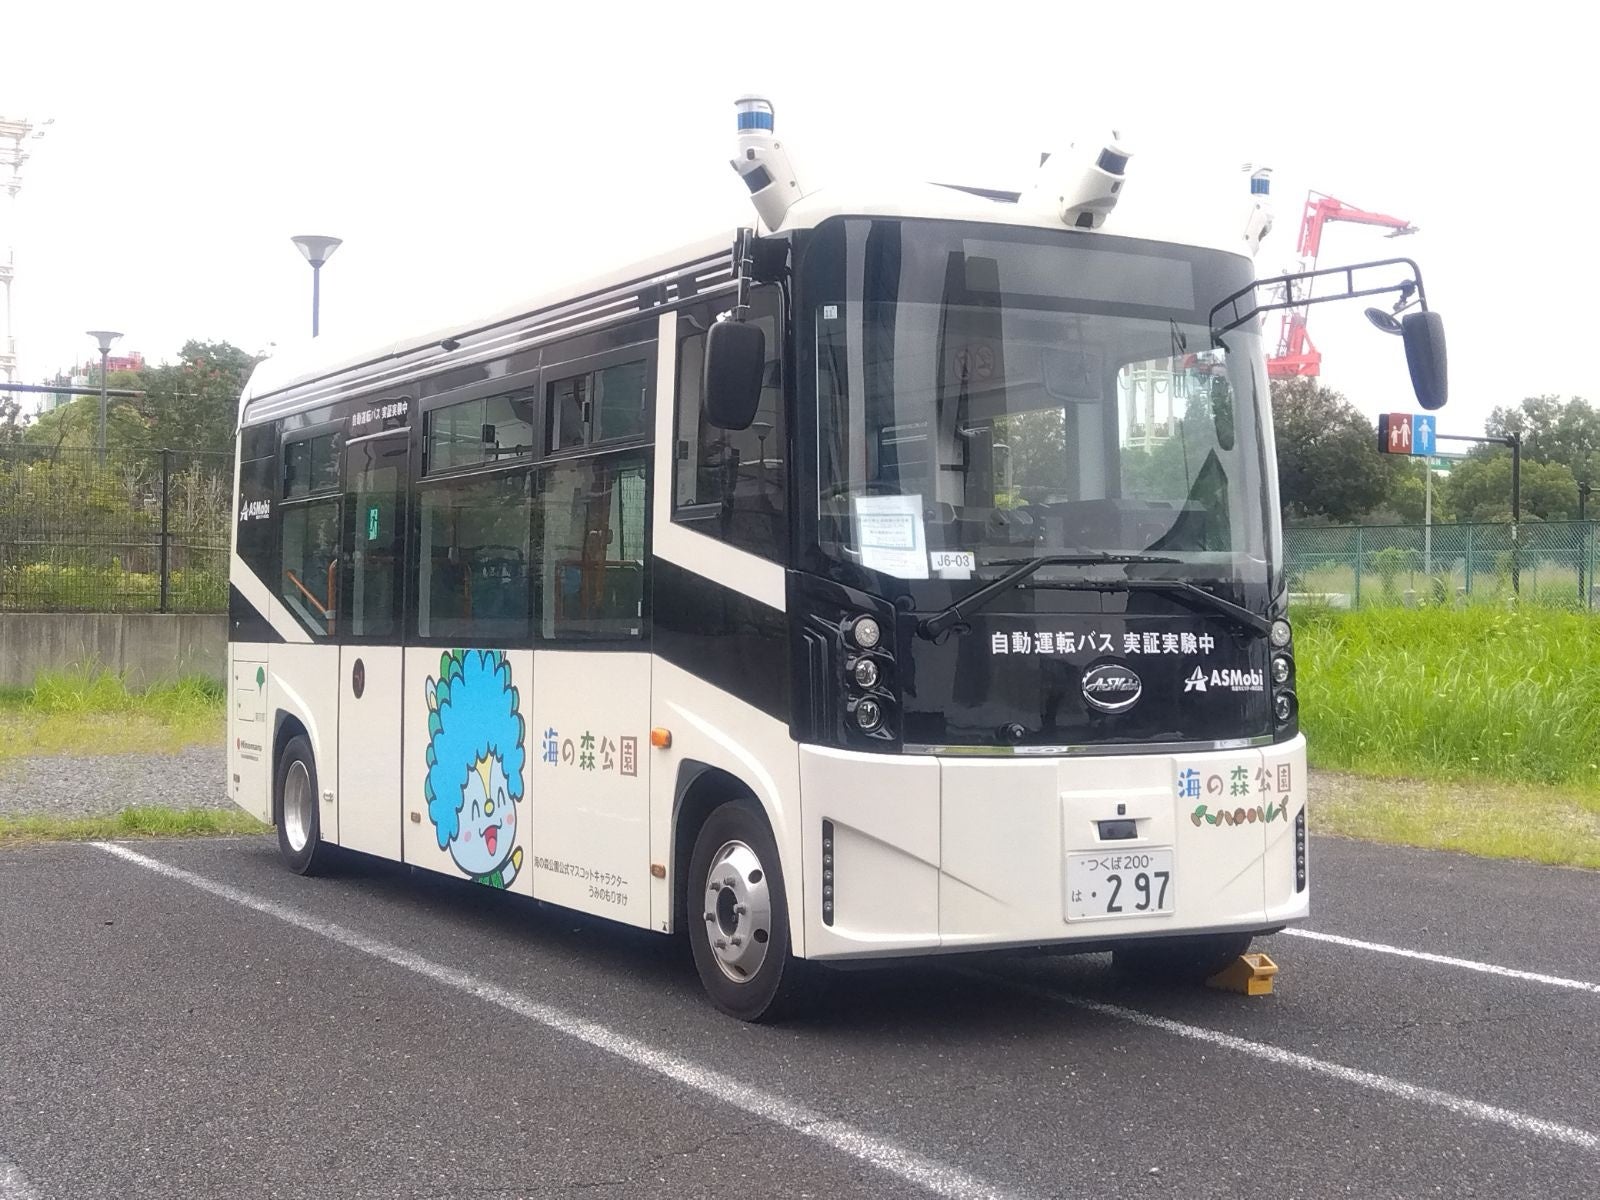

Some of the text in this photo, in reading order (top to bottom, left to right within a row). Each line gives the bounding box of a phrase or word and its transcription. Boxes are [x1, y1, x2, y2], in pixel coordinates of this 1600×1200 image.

[249, 500, 270, 516] ASMobi
[937, 554, 970, 567] J6-03
[991, 630, 1215, 655] 自動運転バス 実証実験中
[1210, 669, 1264, 687] ASMobi
[542, 727, 638, 778] 海の森公園
[1178, 762, 1292, 800] 海の森公園
[534, 856, 629, 888] 海の森公園公式マスコットキャラクター
[588, 885, 629, 906] うみのもりすけ
[1071, 889, 1083, 903] は
